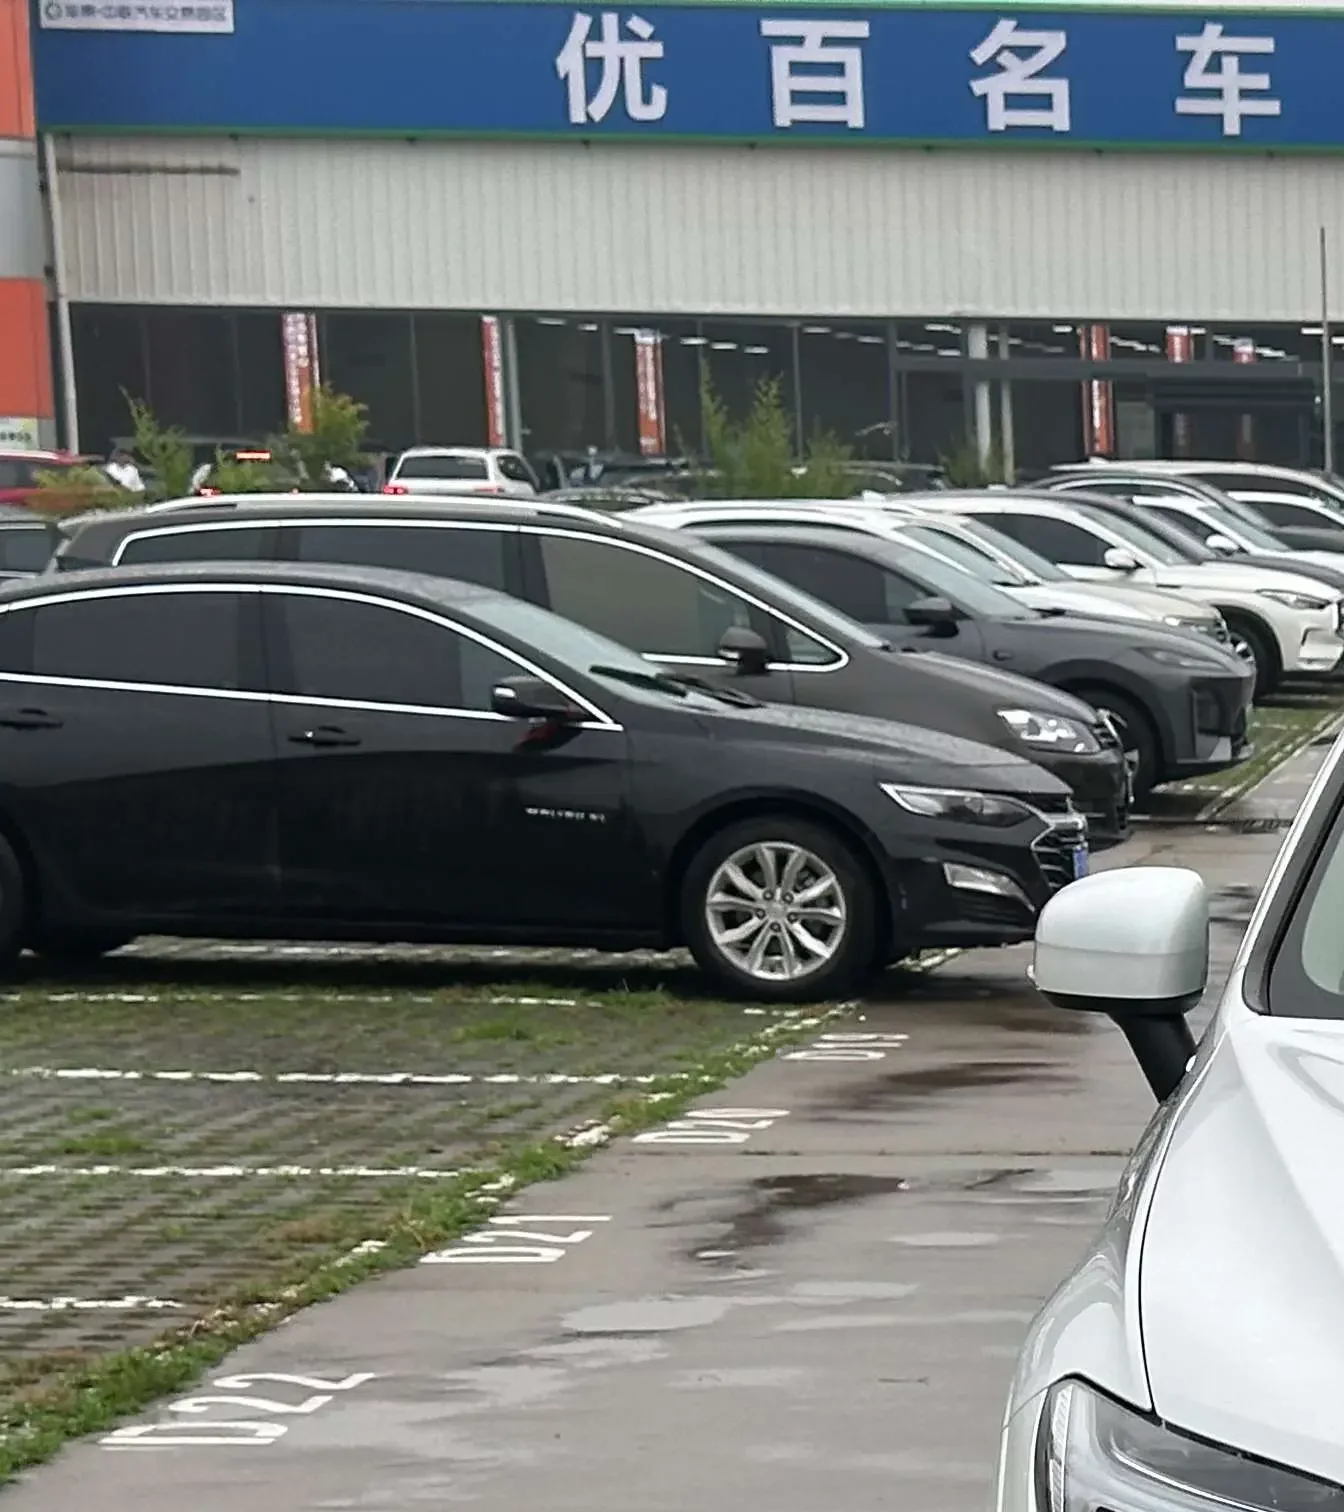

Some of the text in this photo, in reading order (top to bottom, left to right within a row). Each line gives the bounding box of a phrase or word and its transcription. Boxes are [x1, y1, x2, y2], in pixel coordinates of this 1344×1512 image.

[555, 12, 1282, 136] 优百名车
[631, 1107, 791, 1143] D20
[419, 1215, 613, 1263] D21
[97, 1372, 381, 1446] D22
